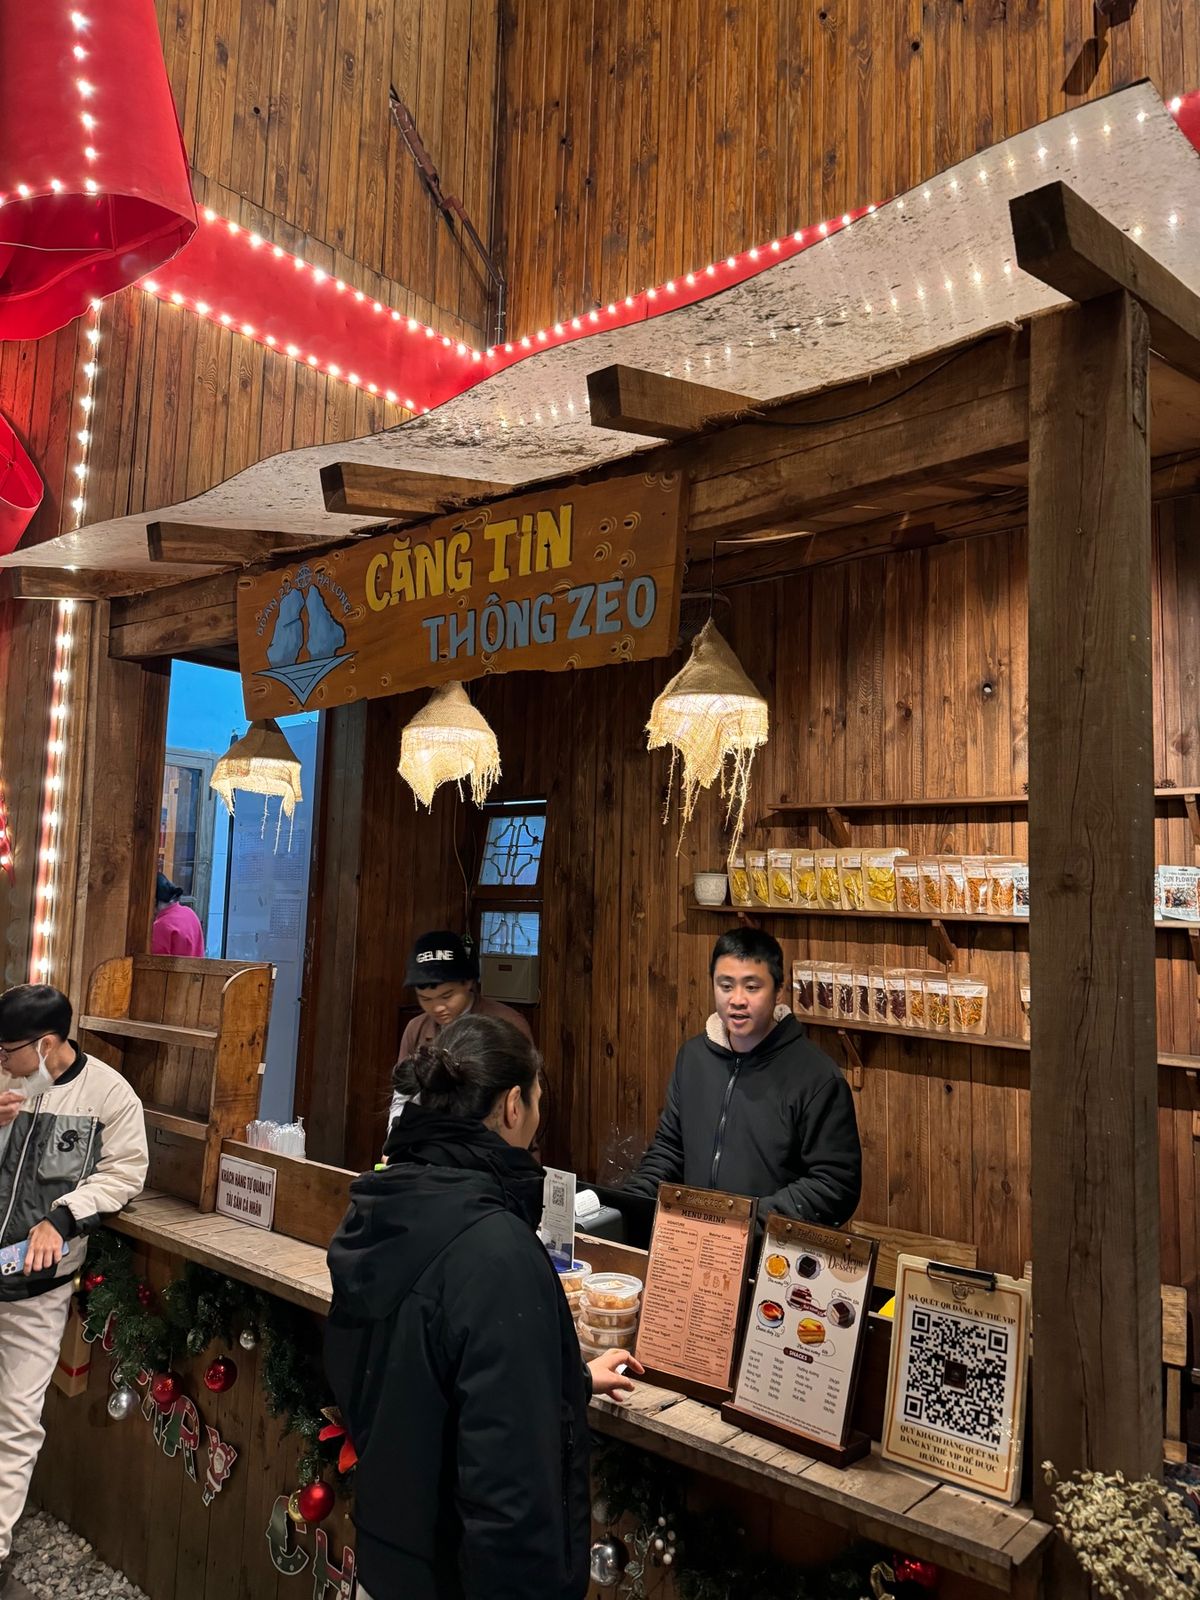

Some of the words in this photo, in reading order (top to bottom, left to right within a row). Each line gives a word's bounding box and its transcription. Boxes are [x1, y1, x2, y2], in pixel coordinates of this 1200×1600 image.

[365, 531, 472, 612] CĂNG
[484, 504, 572, 583] TIN
[422, 592, 555, 663] THÔNG
[567, 576, 656, 640] ZEO
[221, 1167, 234, 1185] KHÁCH
[235, 1171, 246, 1189] HÀNG
[681, 1209, 702, 1221] MENU
[703, 1213, 727, 1224] DRINK
[827, 1255, 858, 1274] Dessert
[908, 1293, 918, 1302] MÃ
[941, 1300, 951, 1310] QR
[1002, 1316, 1016, 1325] VIP
[788, 1350, 808, 1361] SNACKS
[900, 1424, 915, 1436] QUÝ
[916, 1428, 942, 1443] KHÁCH
[943, 1436, 964, 1450] HÀNG
[965, 1445, 986, 1457] QUÉT
[988, 1453, 1000, 1463] MÃ
[921, 1441, 931, 1450] KÝ
[949, 1450, 962, 1460] VIP
[946, 1459, 958, 1470] ƯU
